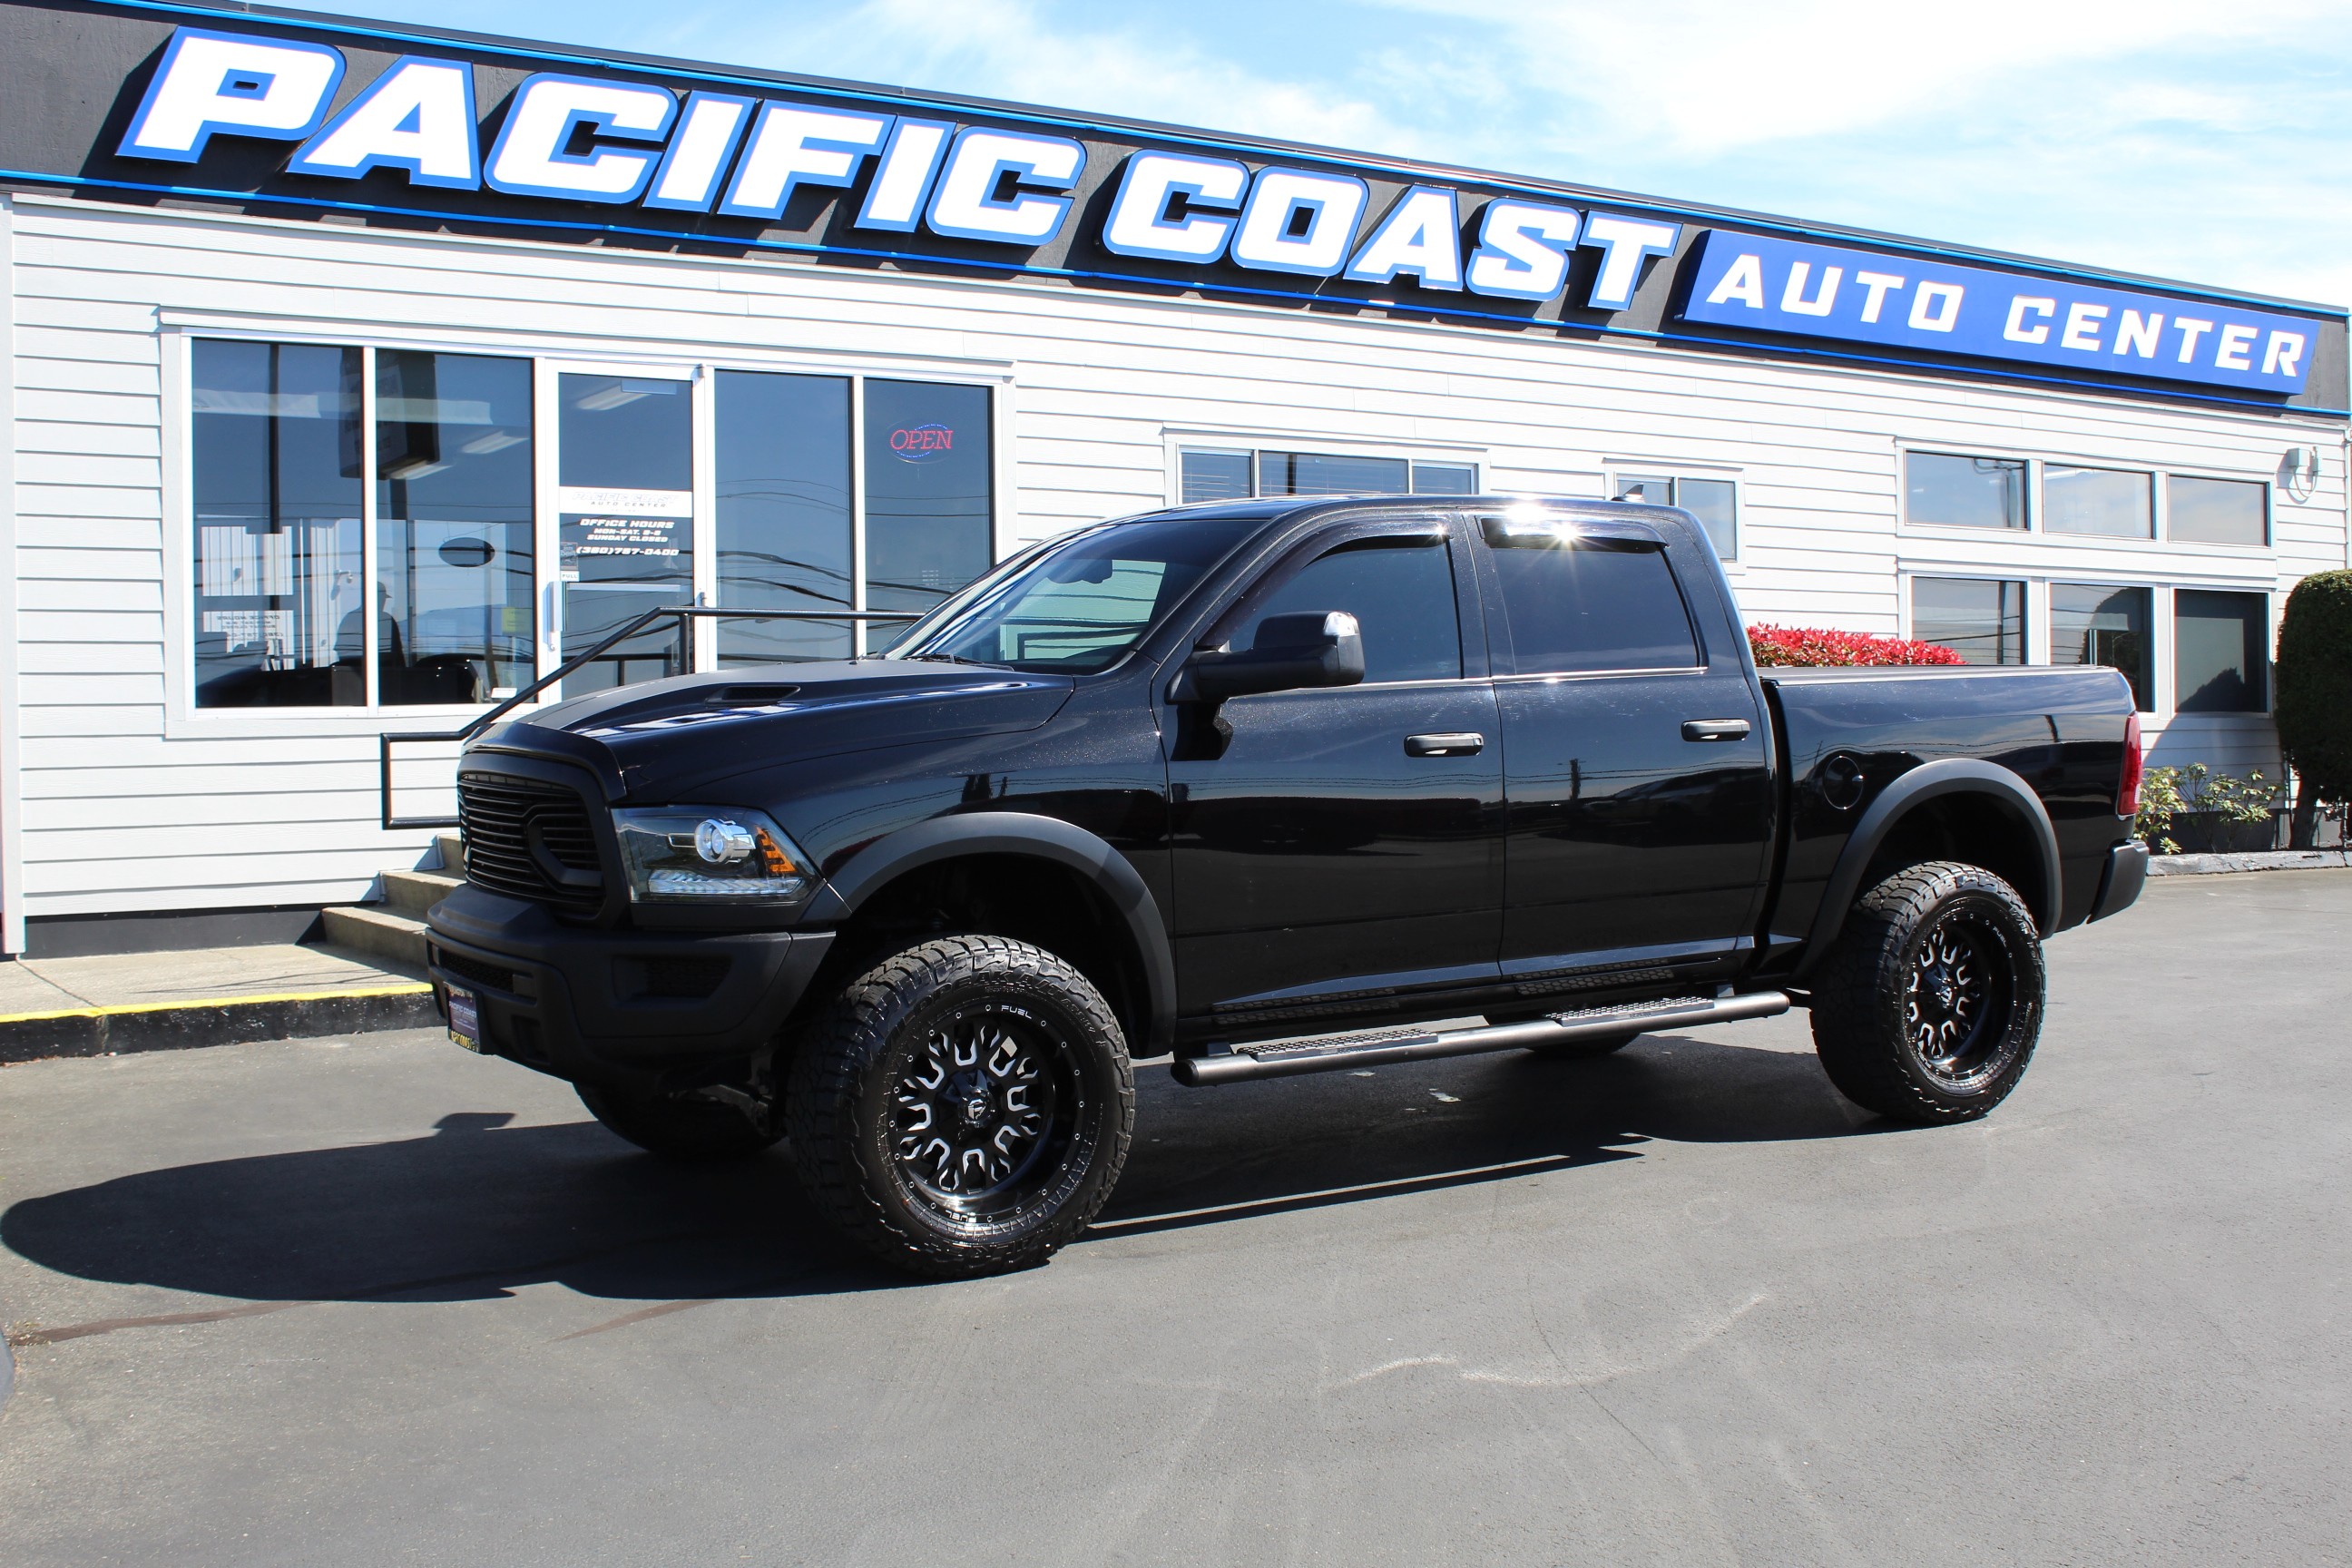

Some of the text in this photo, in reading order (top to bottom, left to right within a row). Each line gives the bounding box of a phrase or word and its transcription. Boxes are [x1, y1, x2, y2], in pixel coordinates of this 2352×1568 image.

[115, 25, 1683, 310] PACIFIC COAST
[1706, 254, 2306, 377] AUTO CENTER
[889, 429, 954, 450] OPEN
[573, 492, 679, 504] PACIFIC COAST
[580, 518, 675, 529] OFFICE HOURS
[593, 527, 641, 535] MON-SAT.
[586, 534, 669, 544] SUNDAY CLOSED
[1001, 1004, 1033, 1020] FUEL
